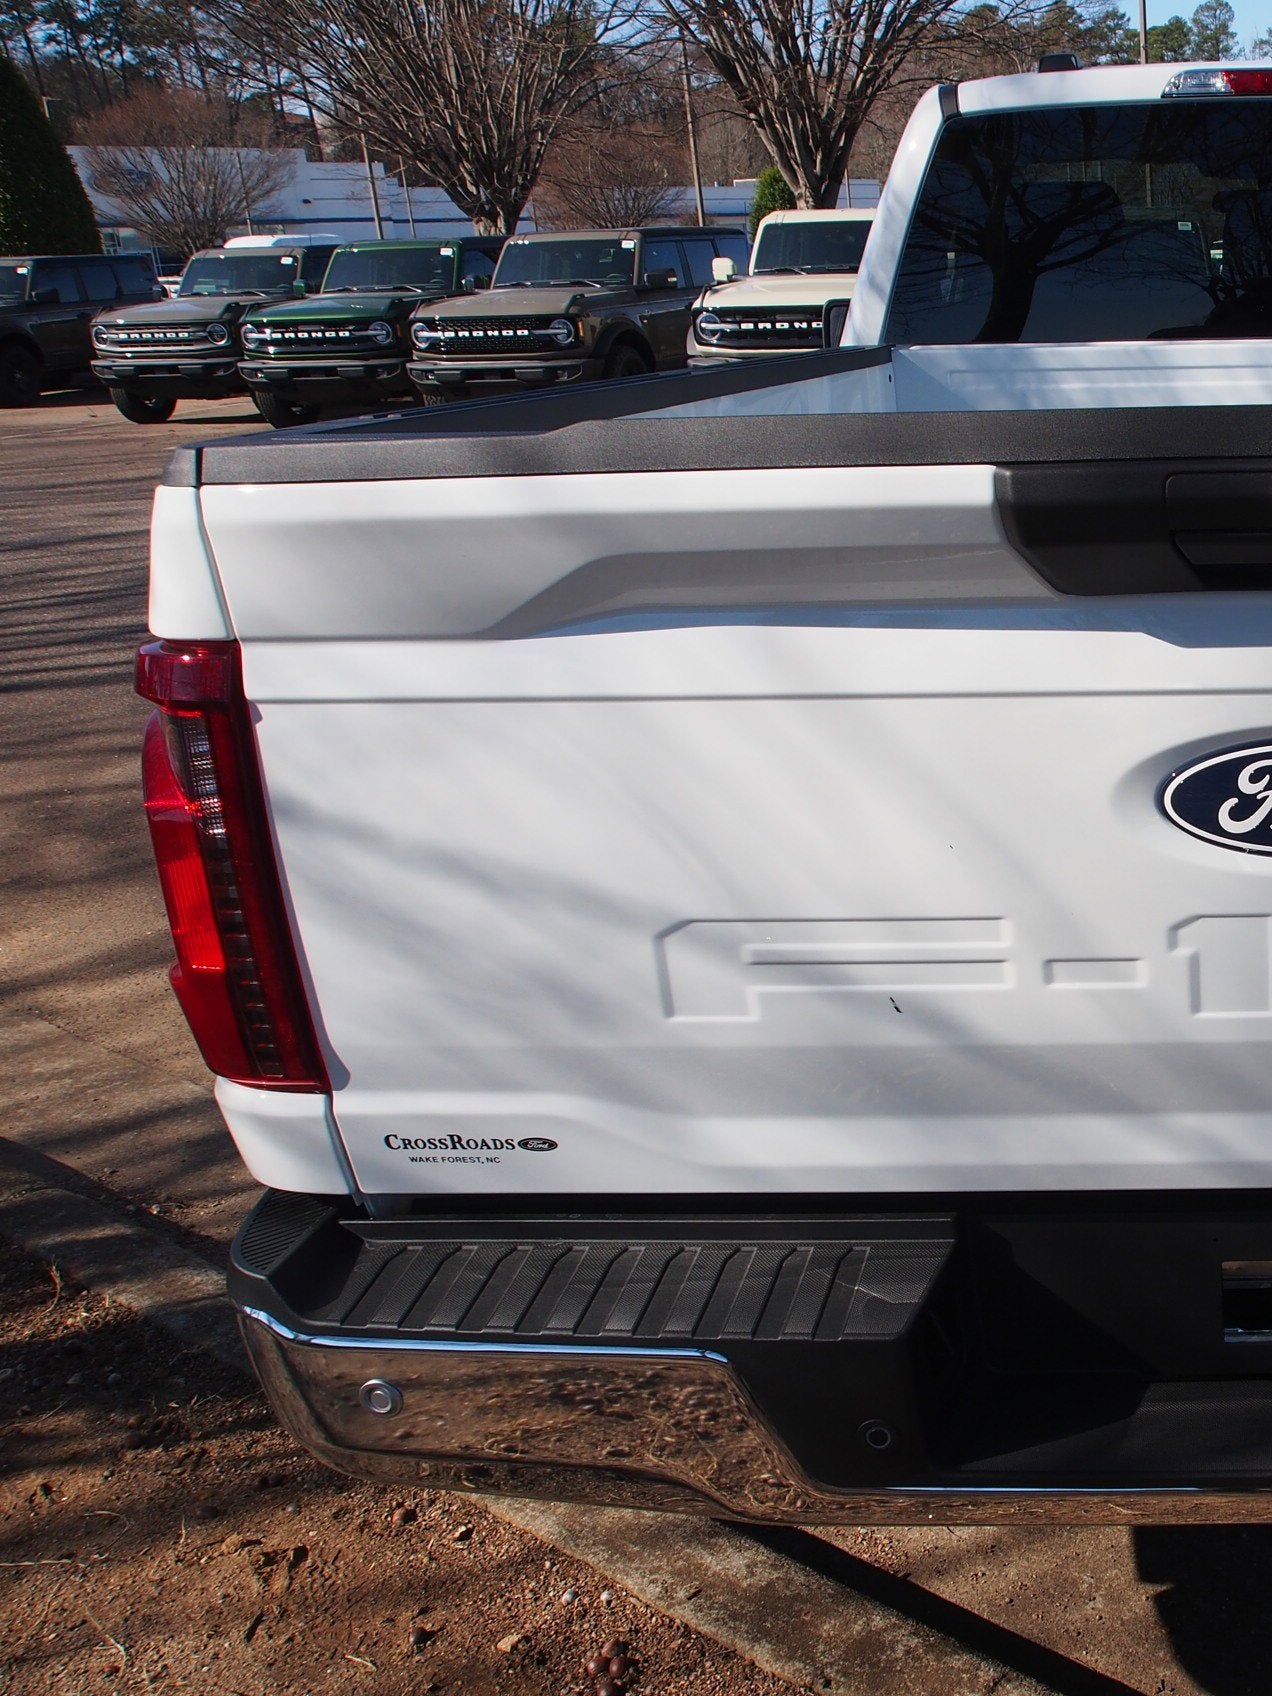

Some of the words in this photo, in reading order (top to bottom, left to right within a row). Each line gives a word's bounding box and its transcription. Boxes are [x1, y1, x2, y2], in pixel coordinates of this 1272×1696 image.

[740, 321, 823, 330] BRONC
[118, 331, 189, 339] BRONCO
[271, 331, 350, 339] BRONCO
[443, 329, 529, 338] BRONCO
[409, 1156, 439, 1164] WAKE
[441, 1156, 485, 1165] FOREST,
[487, 1156, 501, 1164] NC
